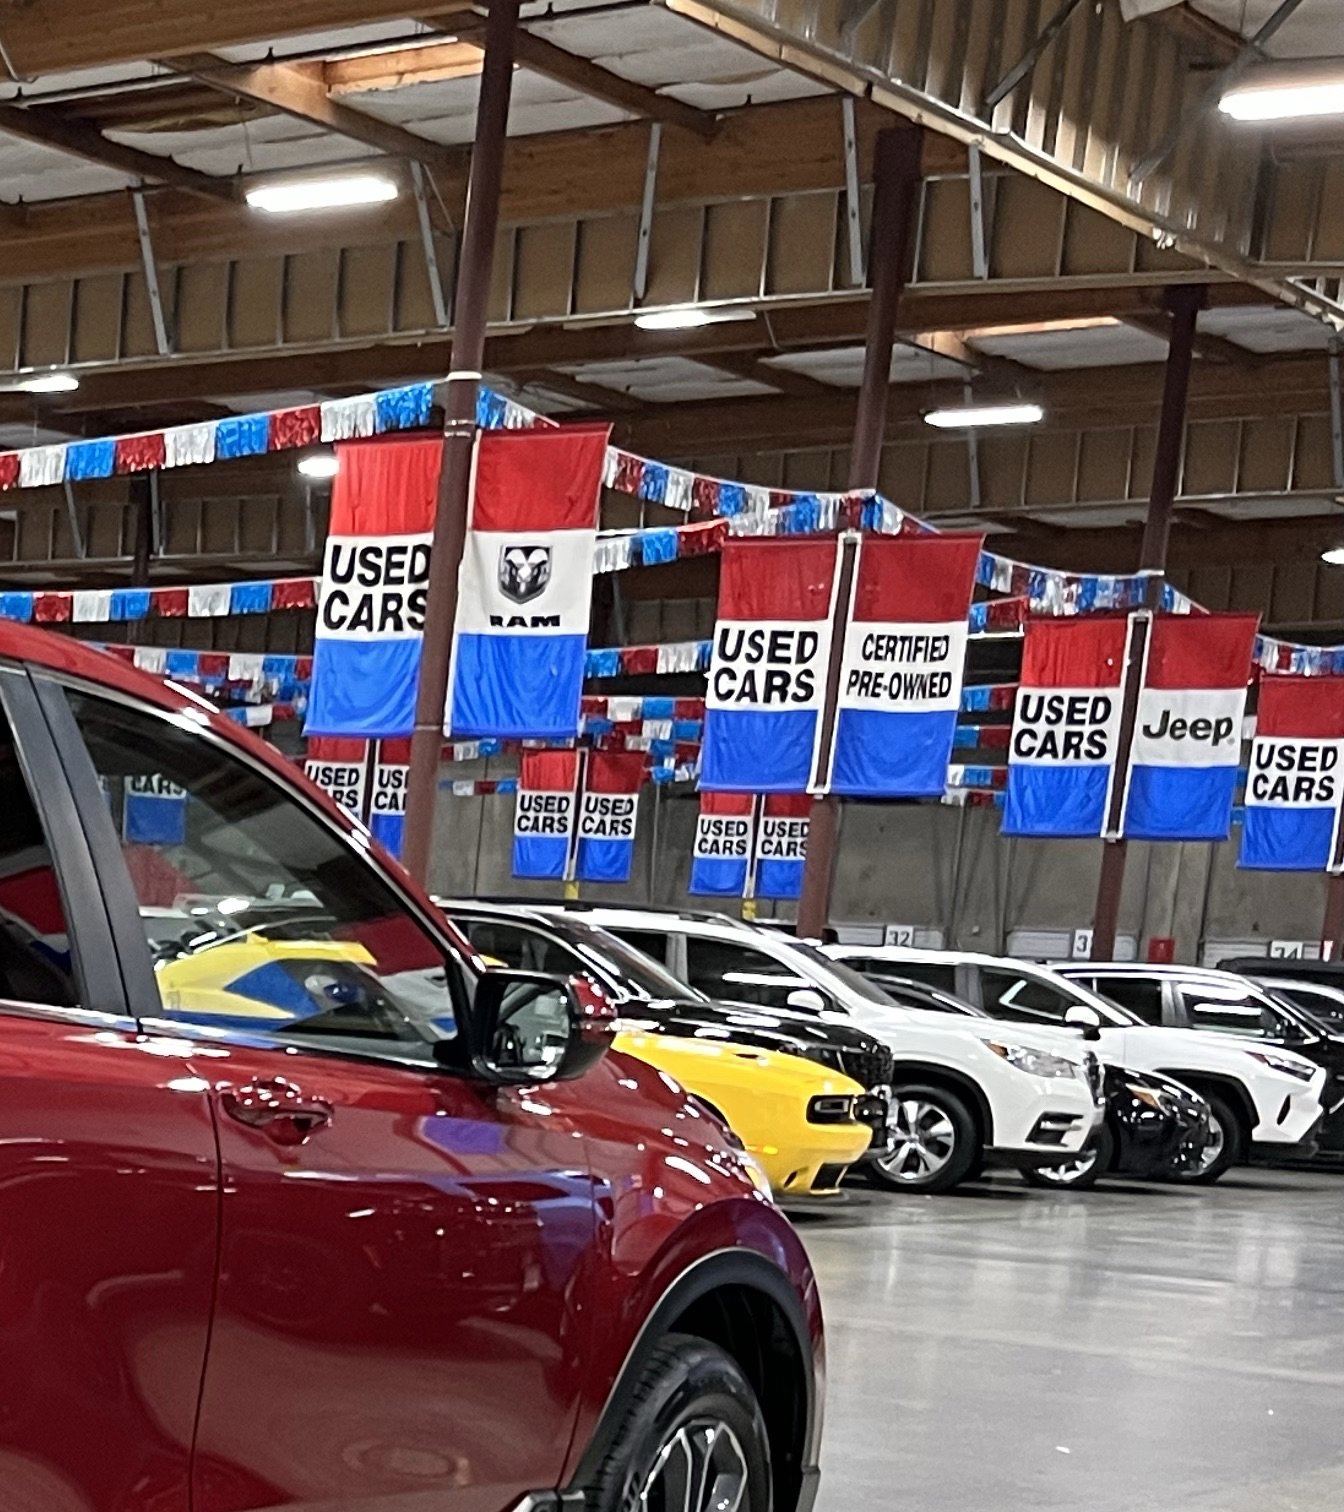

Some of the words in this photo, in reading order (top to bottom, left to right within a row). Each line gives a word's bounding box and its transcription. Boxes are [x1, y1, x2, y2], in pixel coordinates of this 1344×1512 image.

[331, 545, 430, 587] USED
[323, 589, 425, 632] CARS
[490, 615, 560, 628] RAM
[718, 628, 818, 664] USED
[862, 633, 950, 662] CERTIFIED
[714, 667, 815, 704] CARS
[846, 669, 952, 700] PRE-OWNED
[1019, 694, 1111, 726] USED
[1142, 710, 1233, 746] Jeep
[1014, 729, 1107, 760] CARS
[1255, 744, 1338, 772] USED
[307, 766, 359, 787] USED
[379, 769, 408, 789] US
[1252, 773, 1335, 801] CARS
[333, 789, 359, 808] RS
[374, 791, 407, 810] CA
[520, 795, 570, 813] USED
[584, 796, 634, 816] USED
[517, 815, 568, 834] CARS
[582, 816, 632, 836] CARS
[700, 819, 748, 837] USED
[764, 821, 809, 838] USED
[698, 838, 747, 855] CARS
[761, 840, 807, 857] CARS
